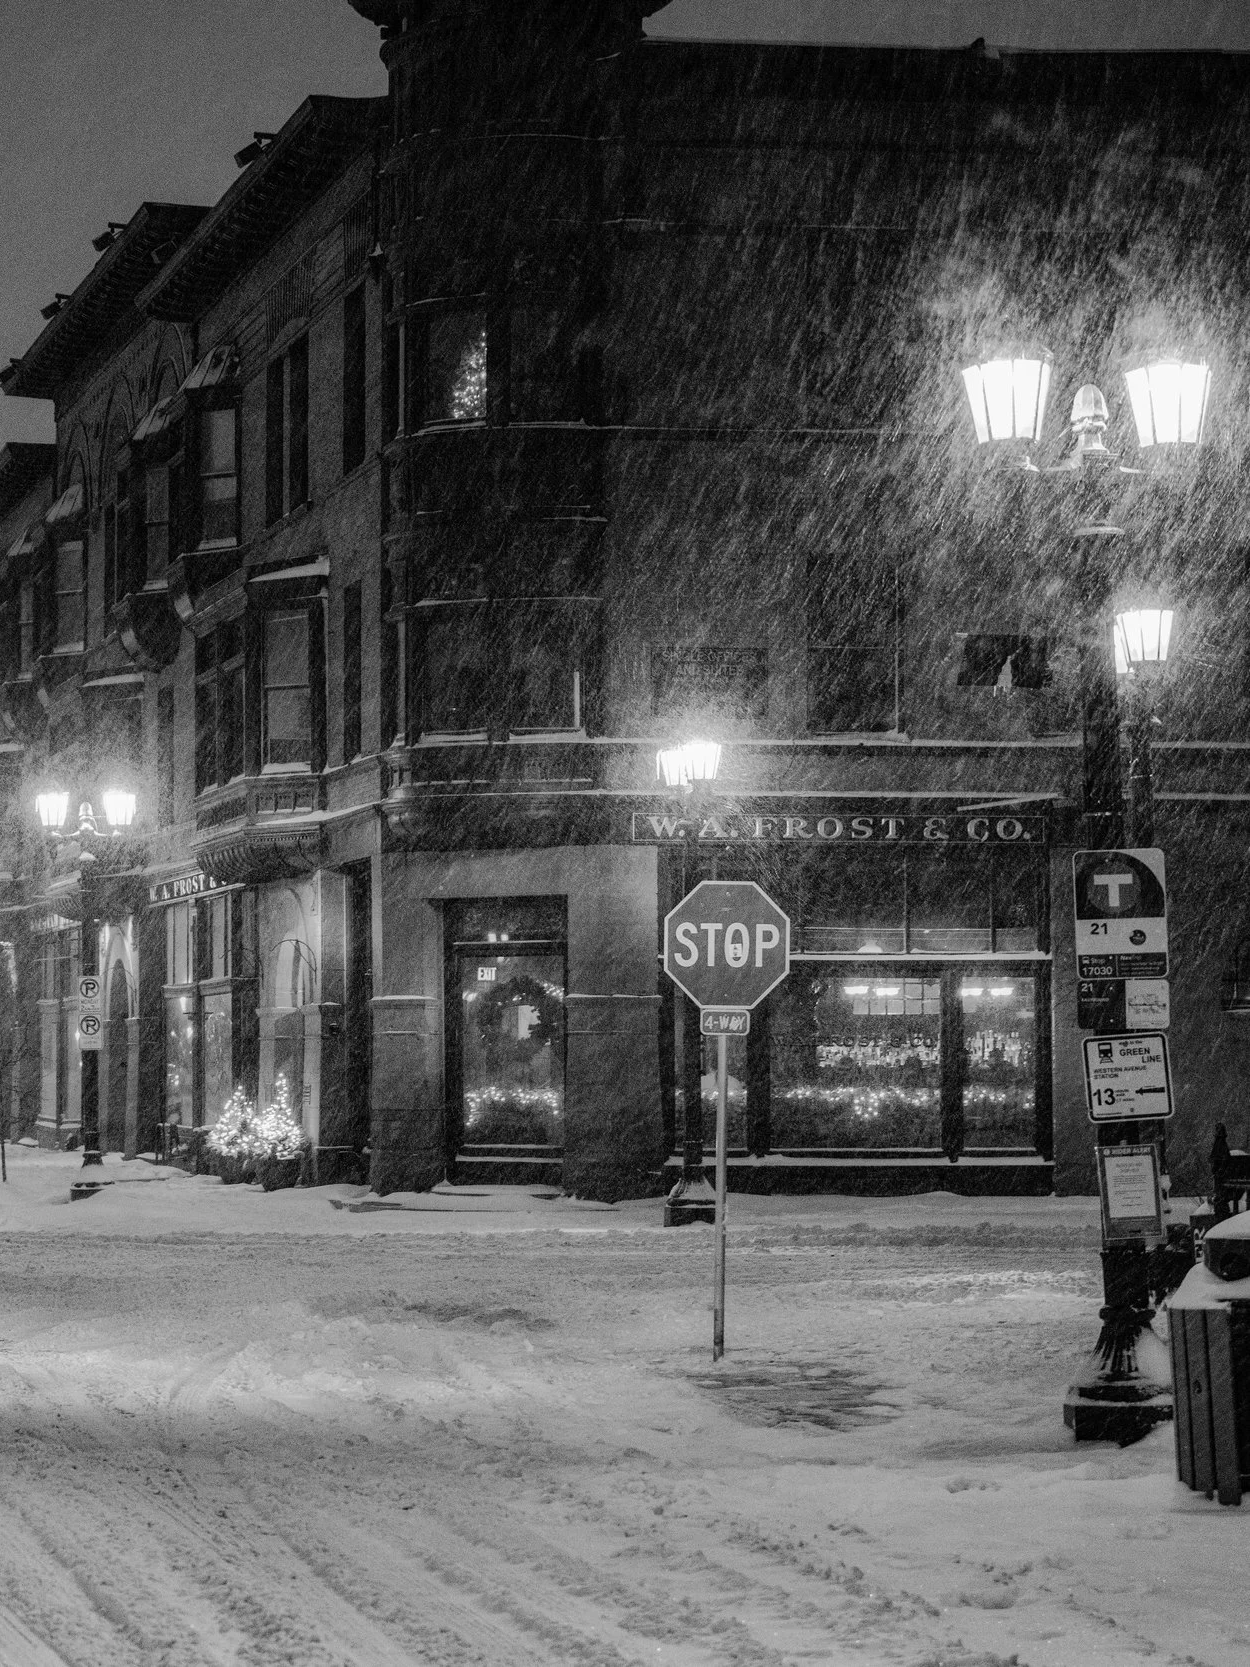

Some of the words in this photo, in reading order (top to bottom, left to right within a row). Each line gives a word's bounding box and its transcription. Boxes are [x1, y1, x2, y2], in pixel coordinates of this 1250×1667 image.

[649, 816, 686, 837] W.
[697, 816, 739, 837] A.
[752, 816, 905, 838] FROST
[923, 817, 950, 839] &
[966, 818, 1031, 841] CO.
[173, 873, 205, 897] FROST
[1093, 874, 1133, 907] T
[1090, 923, 1108, 935] 21
[674, 922, 780, 967] STOP
[477, 966, 497, 981] EXIT
[1082, 966, 1113, 976] 17030
[1081, 983, 1093, 992] 21
[1119, 1047, 1150, 1057] GREEN
[1142, 1055, 1162, 1063] LINE
[1093, 1087, 1116, 1106] 13
[1132, 1146, 1151, 1154] ALERT
